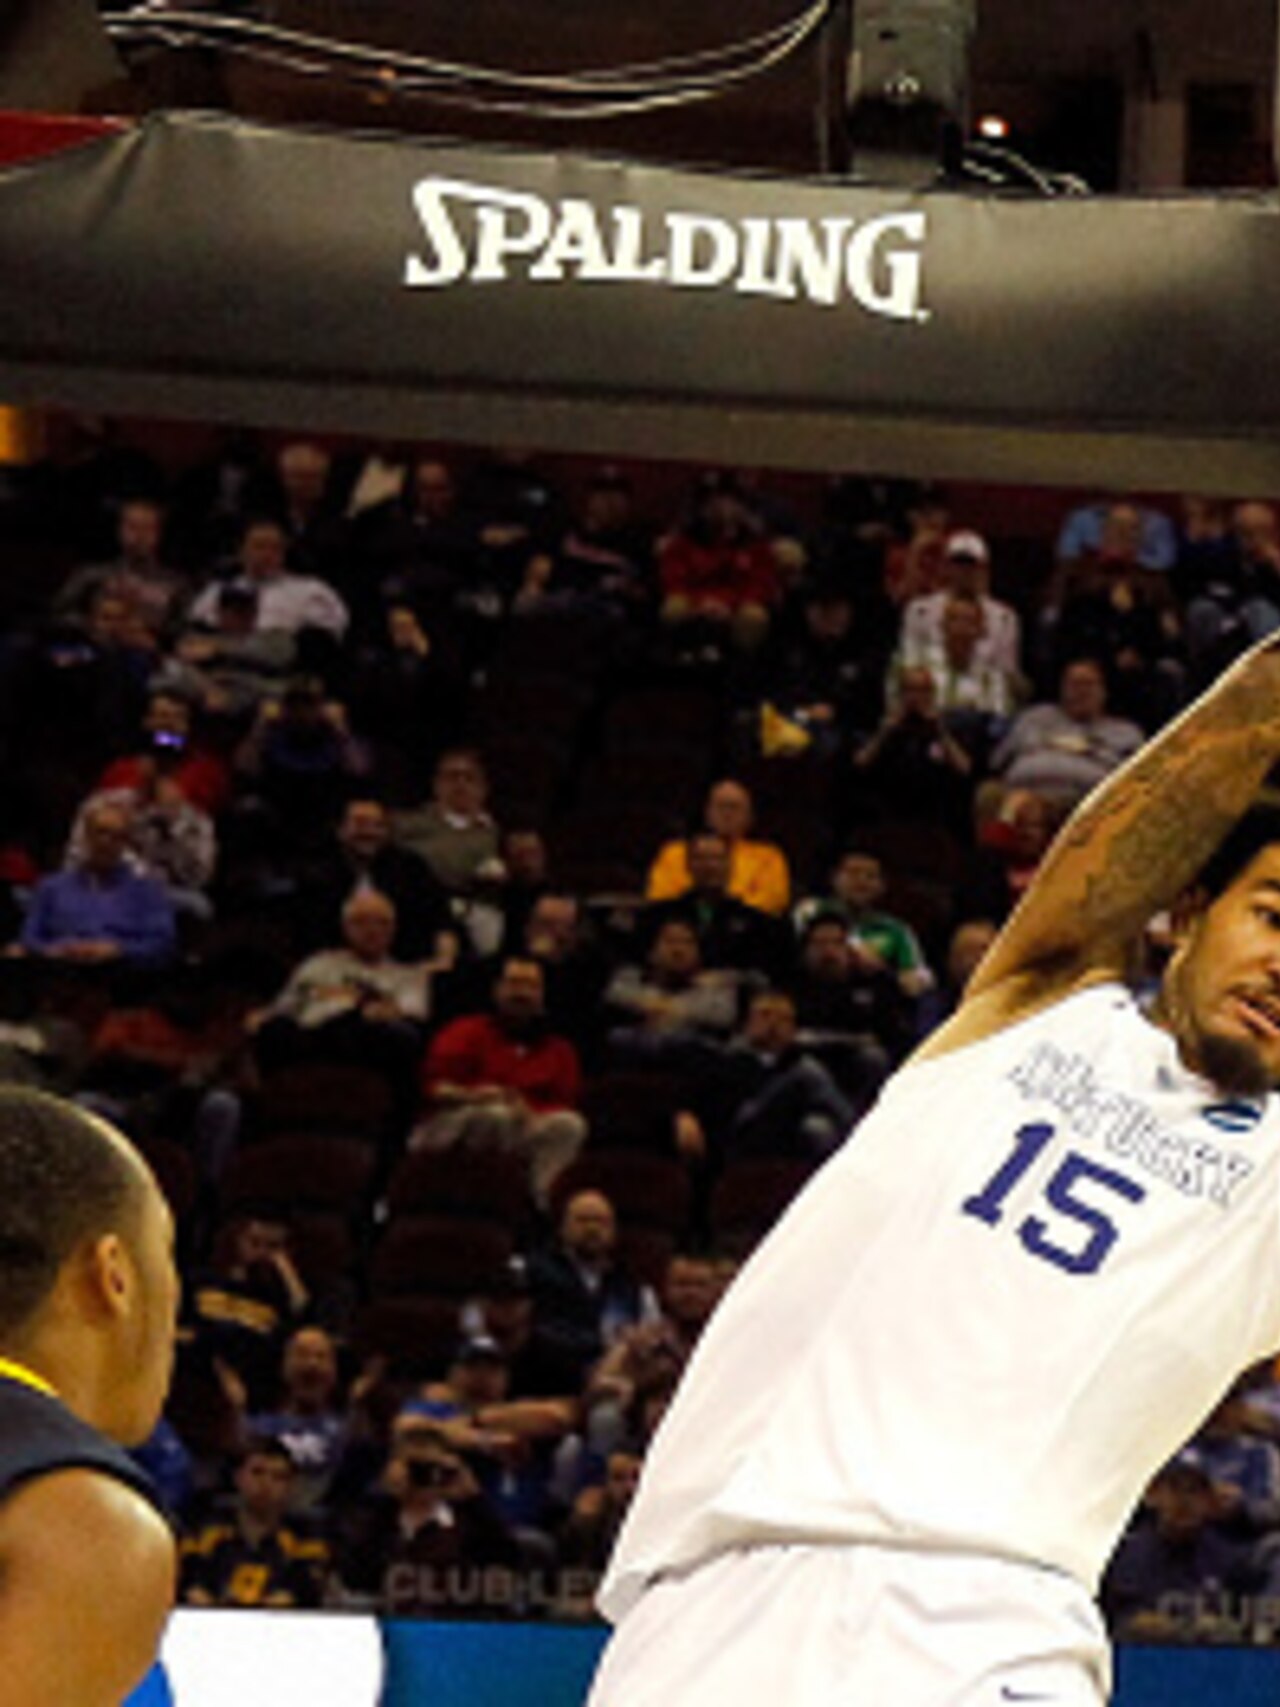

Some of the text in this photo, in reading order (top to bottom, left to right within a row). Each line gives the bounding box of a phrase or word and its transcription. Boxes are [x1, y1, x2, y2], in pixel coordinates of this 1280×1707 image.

[405, 176, 928, 321] SPALDING
[962, 1120, 1147, 1275] 15
[386, 1563, 514, 1605] CLUB
